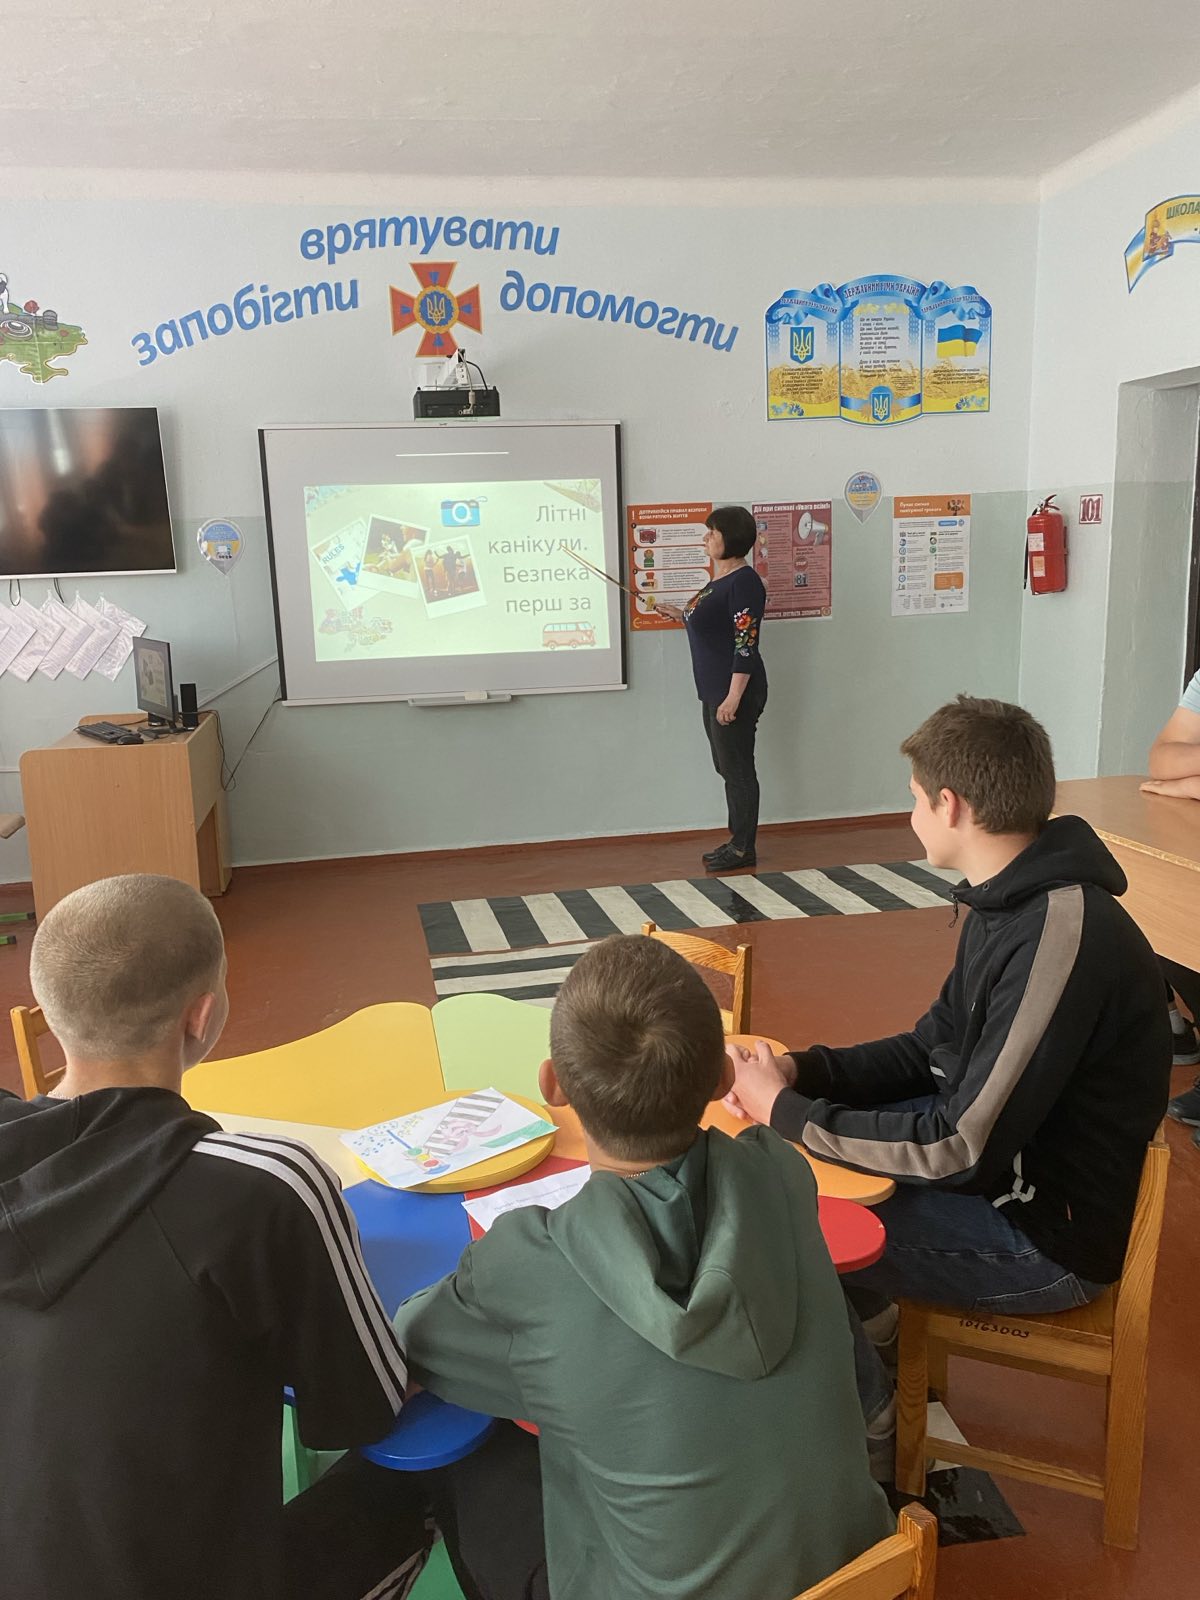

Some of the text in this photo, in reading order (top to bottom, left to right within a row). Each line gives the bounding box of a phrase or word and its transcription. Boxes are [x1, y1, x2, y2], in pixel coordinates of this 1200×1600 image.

[300, 215, 560, 264] врятувати
[131, 279, 359, 366] запобігти
[500, 270, 739, 352] допомогти
[536, 505, 586, 523] Літні
[1081, 498, 1101, 522] 101
[503, 565, 590, 583] Безпека
[506, 596, 591, 616] перш за
